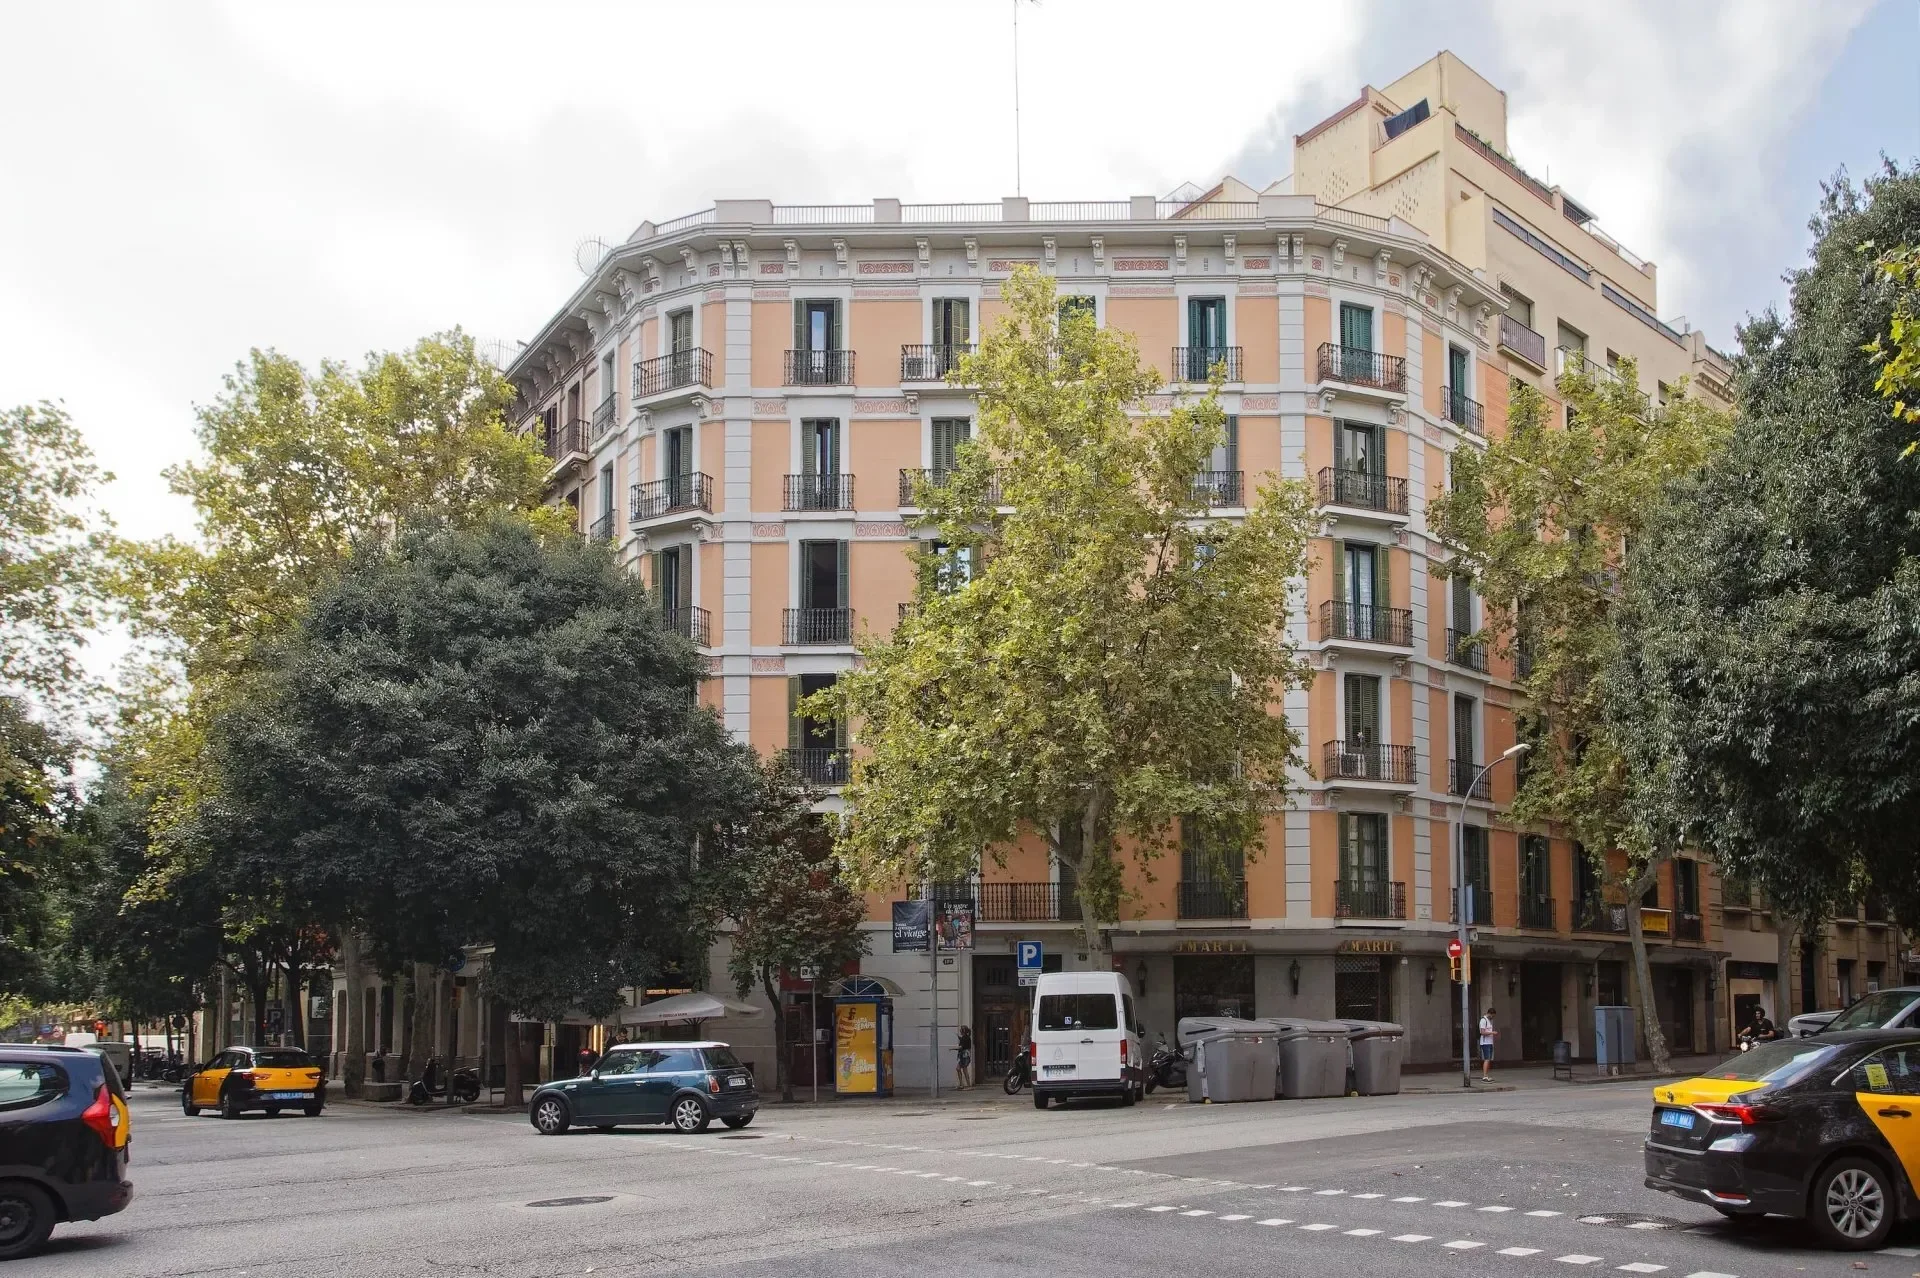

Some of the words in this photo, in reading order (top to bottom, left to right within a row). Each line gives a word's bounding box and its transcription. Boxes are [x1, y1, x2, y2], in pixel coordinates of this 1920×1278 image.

[894, 929, 902, 938] el
[904, 929, 927, 939] viatge
[1022, 944, 1037, 965] P
